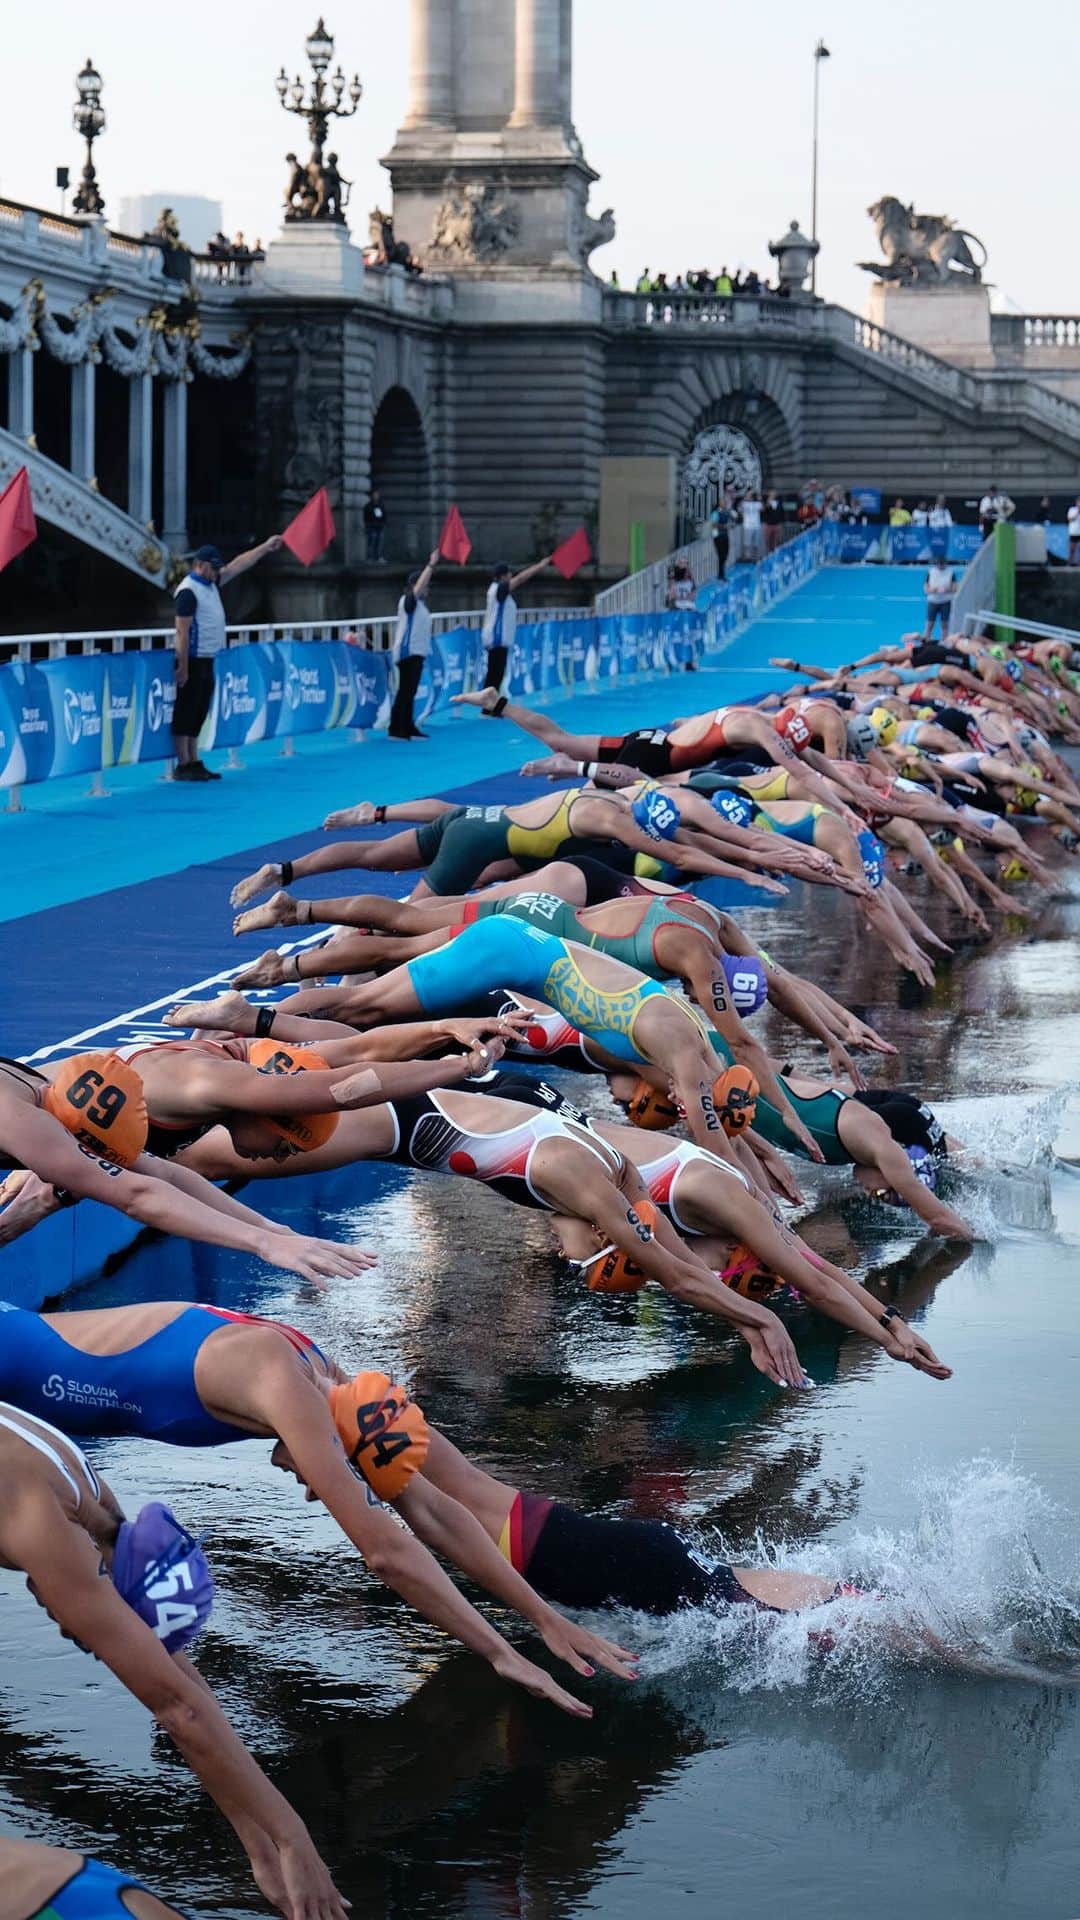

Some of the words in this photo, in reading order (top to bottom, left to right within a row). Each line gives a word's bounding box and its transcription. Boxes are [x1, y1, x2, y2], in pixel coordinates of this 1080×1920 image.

[787, 716, 810, 743] 29
[650, 800, 676, 829] 38
[721, 798, 747, 824] 35
[711, 981, 728, 1013] 60
[731, 972, 758, 1008] 60
[66, 1069, 127, 1130] 69
[700, 1094, 721, 1134] 62
[626, 1207, 653, 1243] 68
[66, 1391, 143, 1414] TRIATHLON
[67, 1379, 119, 1399] SLOVAK
[357, 1398, 412, 1469] 64
[144, 1559, 198, 1640] 54
